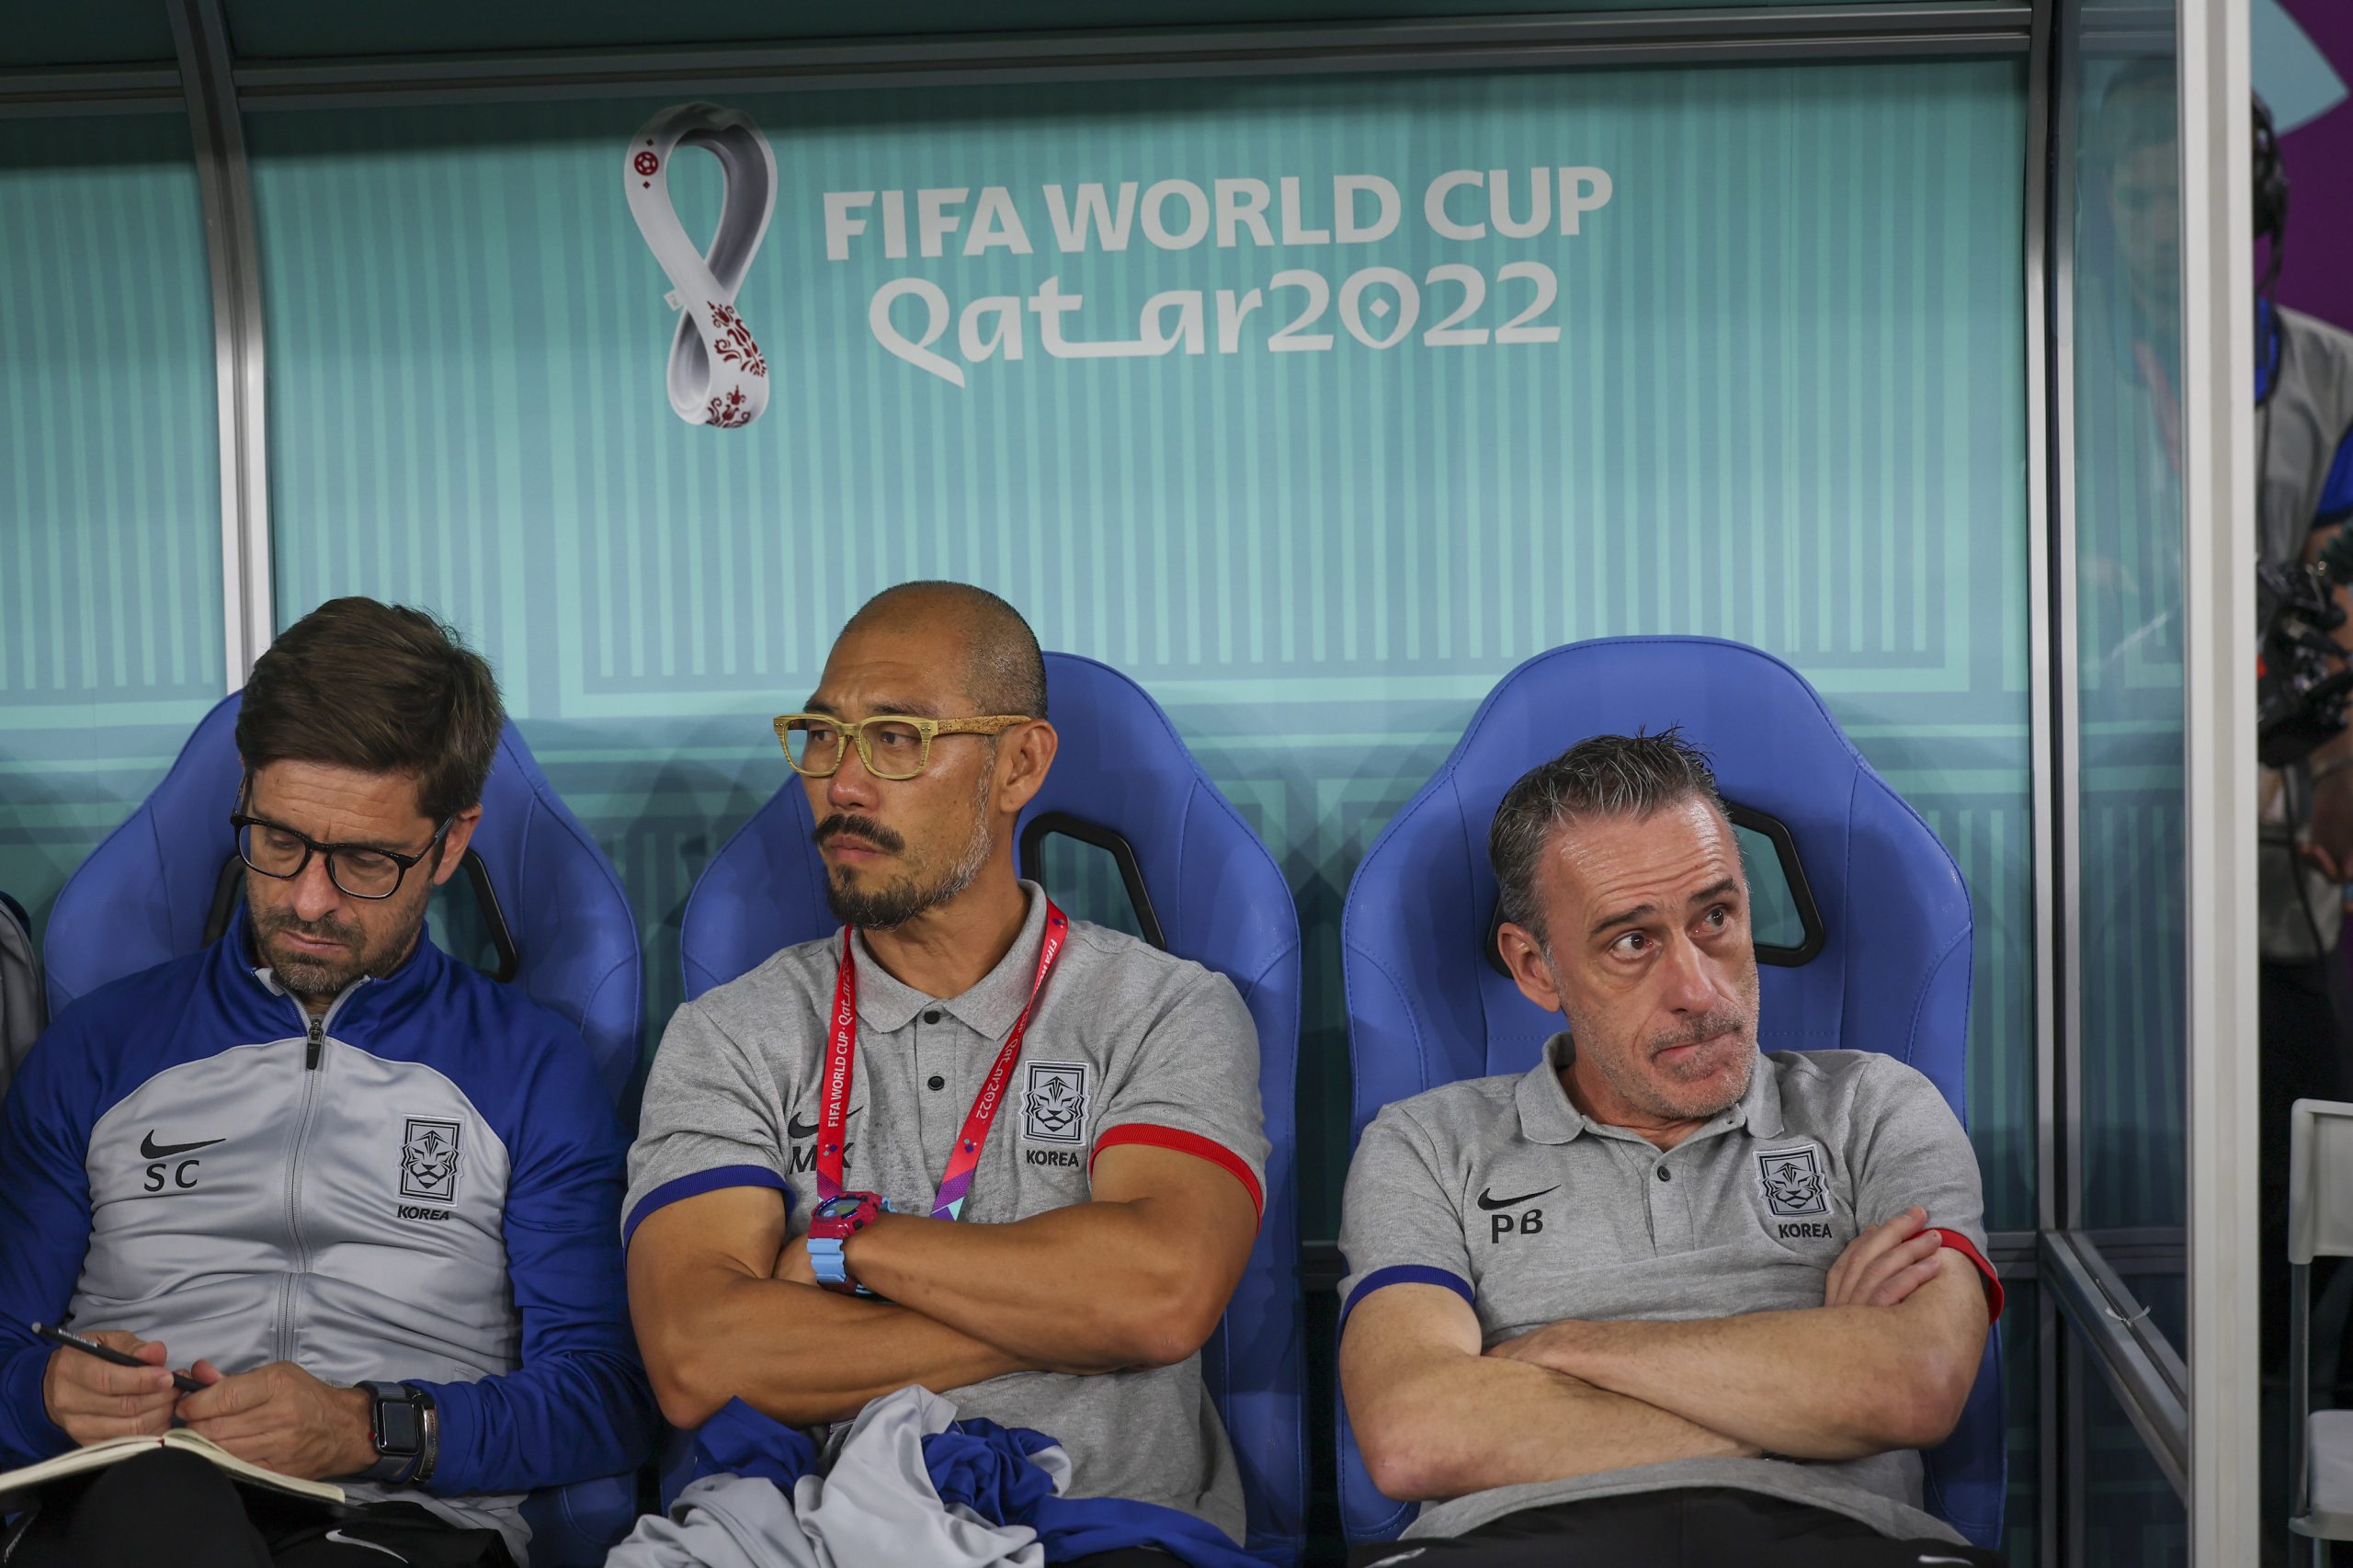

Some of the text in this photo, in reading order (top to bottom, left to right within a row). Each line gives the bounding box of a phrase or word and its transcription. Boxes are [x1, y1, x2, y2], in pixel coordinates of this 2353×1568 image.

[824, 166, 1612, 260] FIFA WORLD CUP
[1045, 938, 1058, 965] FIFA
[837, 1030, 849, 1055] CUP
[831, 1056, 847, 1100] WORLD
[828, 1100, 841, 1128] FIFA
[1026, 1149, 1080, 1168] KOREA
[397, 1204, 450, 1221] KOREA
[1778, 1222, 1833, 1240] KOREA
